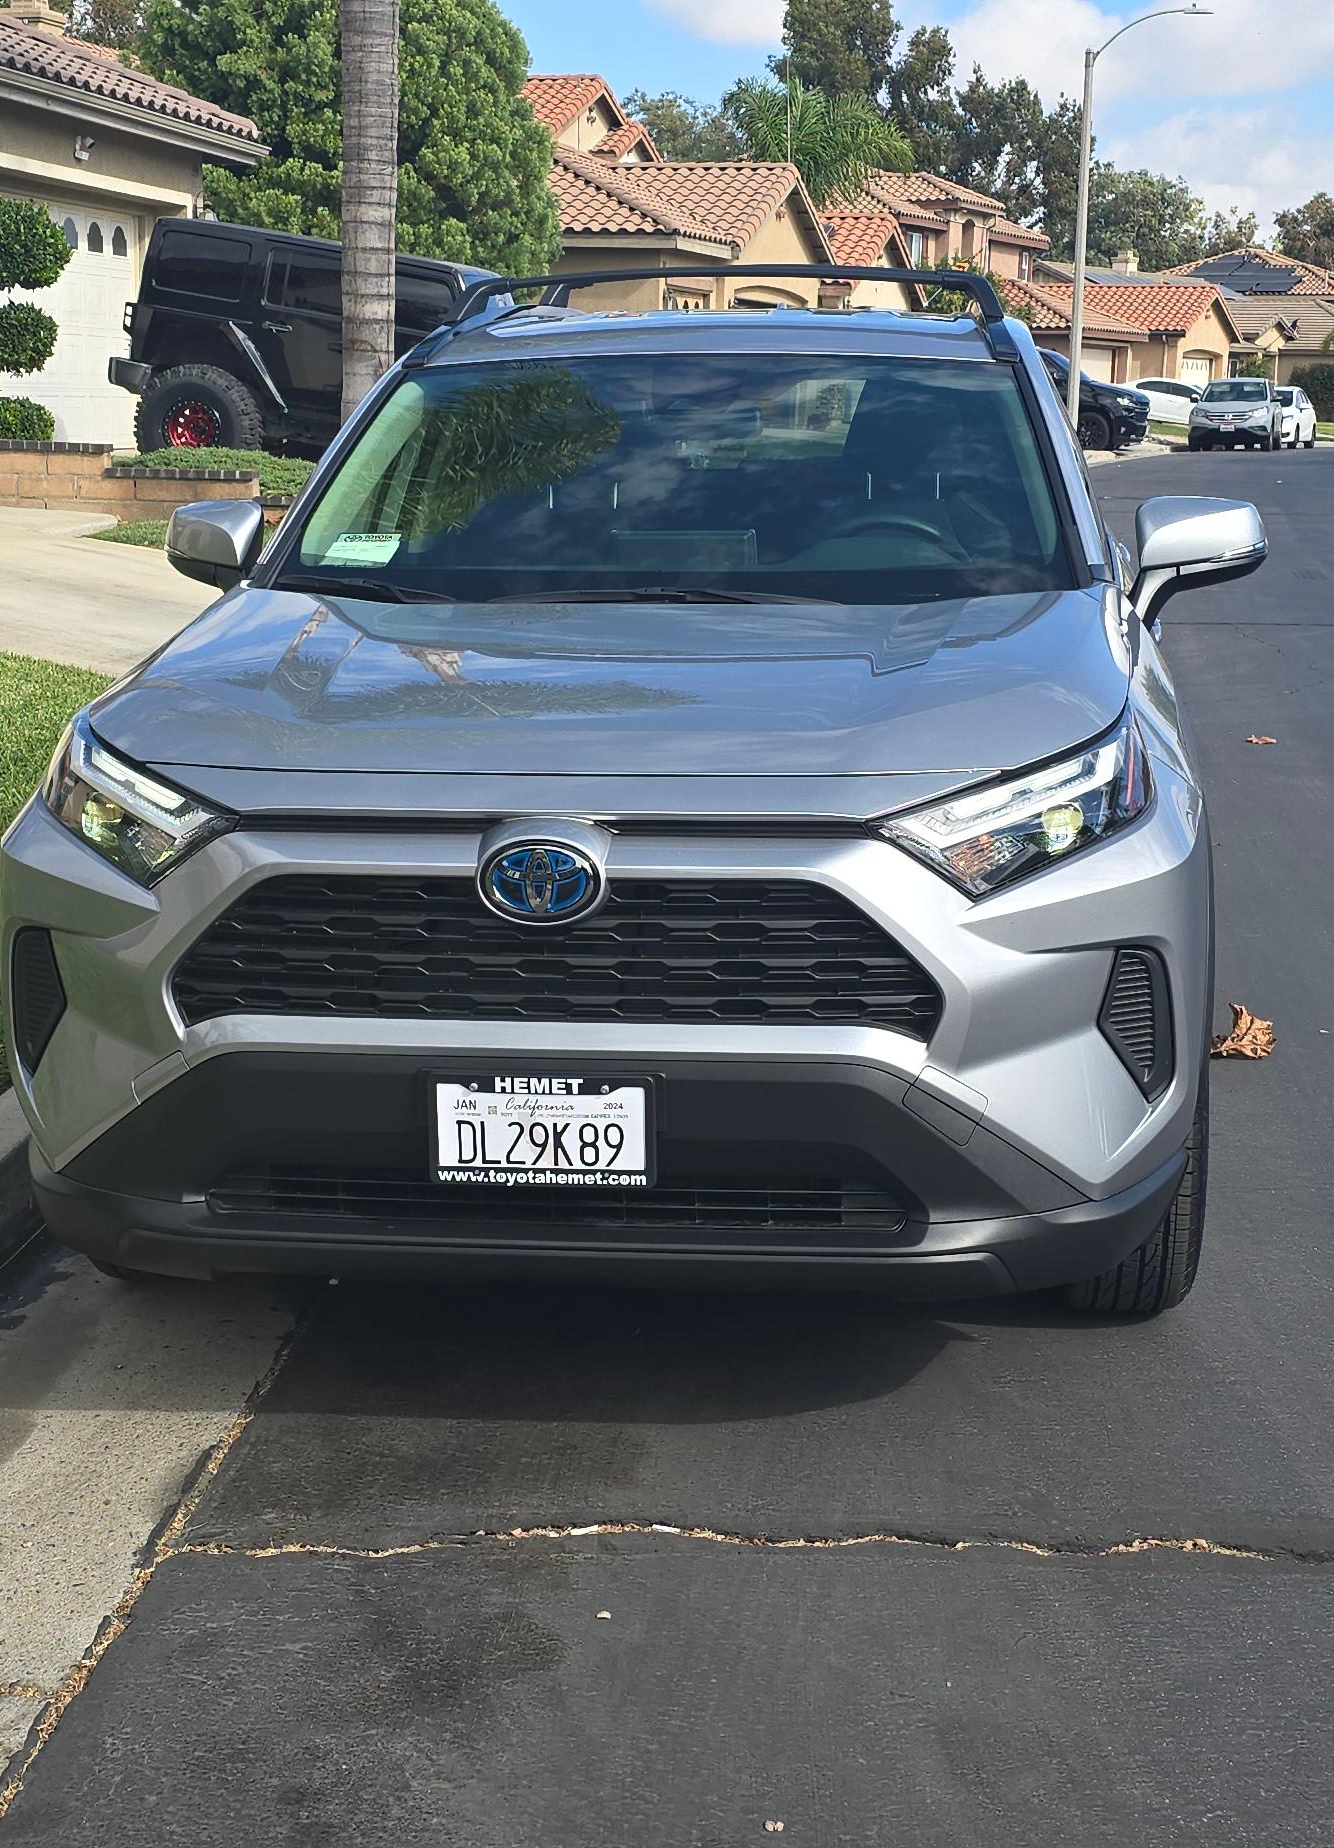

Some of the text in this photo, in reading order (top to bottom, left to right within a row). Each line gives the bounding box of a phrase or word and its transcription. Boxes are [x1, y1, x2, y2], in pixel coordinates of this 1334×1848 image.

[495, 1077, 584, 1095] HEMET
[453, 1099, 477, 1110] JAN
[505, 1096, 575, 1117] California
[603, 1102, 624, 1110] 2024
[455, 1119, 625, 1167] DL29K89
[438, 1170, 647, 1186] www.toyotahemet.com
